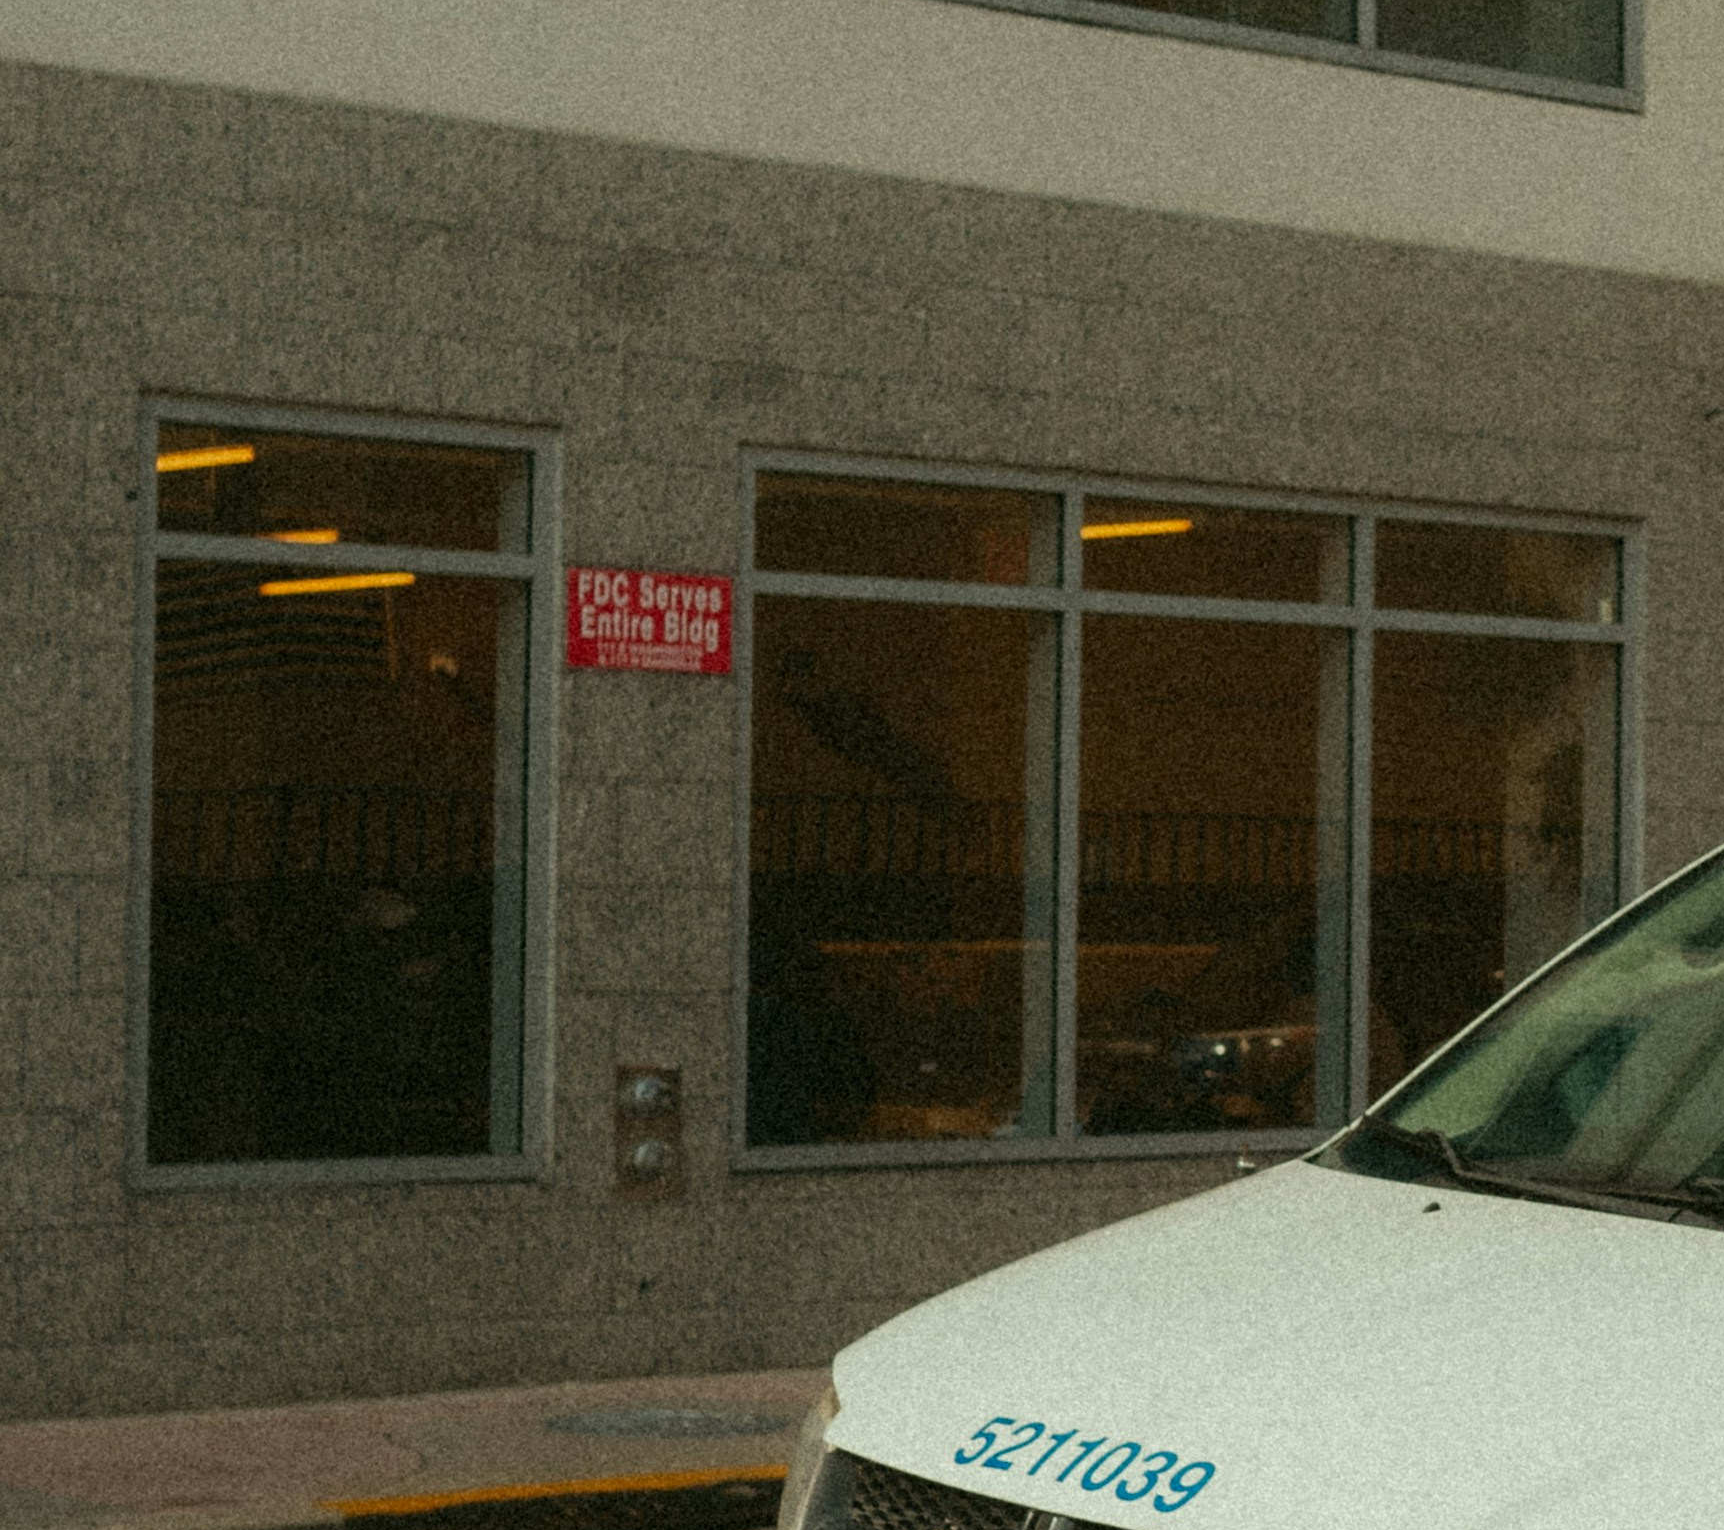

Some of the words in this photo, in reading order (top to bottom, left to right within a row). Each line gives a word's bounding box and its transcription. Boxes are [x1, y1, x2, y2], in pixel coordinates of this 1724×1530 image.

[578, 570, 630, 607] FDC
[639, 575, 722, 613] Serves
[581, 605, 655, 642] Entire
[663, 610, 720, 653] Bldg
[954, 1416, 1217, 1513] 5211039
